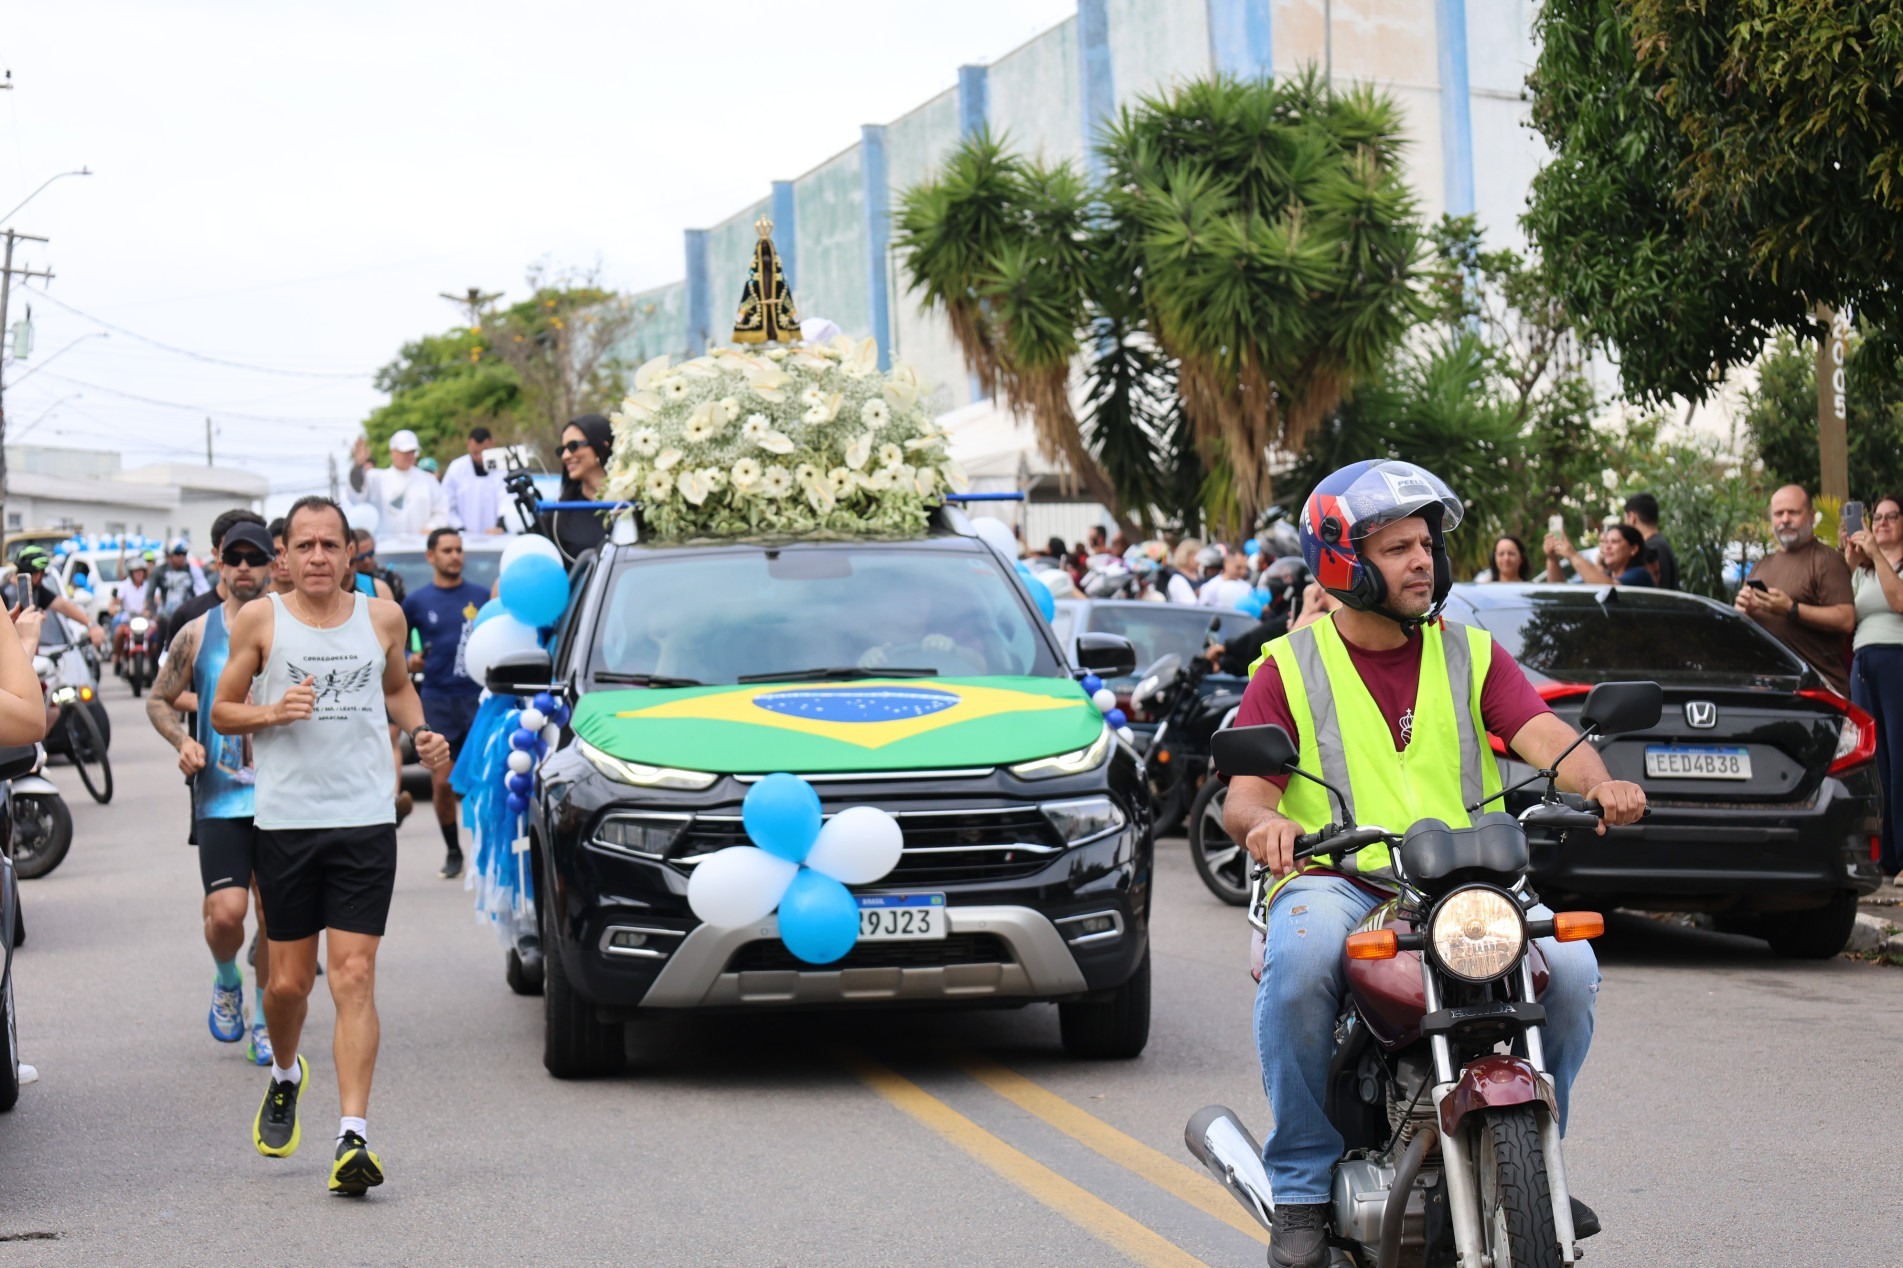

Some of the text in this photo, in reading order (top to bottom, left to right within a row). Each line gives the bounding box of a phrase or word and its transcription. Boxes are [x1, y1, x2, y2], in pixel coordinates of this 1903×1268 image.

[1832, 312, 1846, 420] 2005
[1397, 479, 1424, 487] PEELS
[1656, 754, 1740, 773] EED4B38
[862, 897, 885, 905] BRASIL
